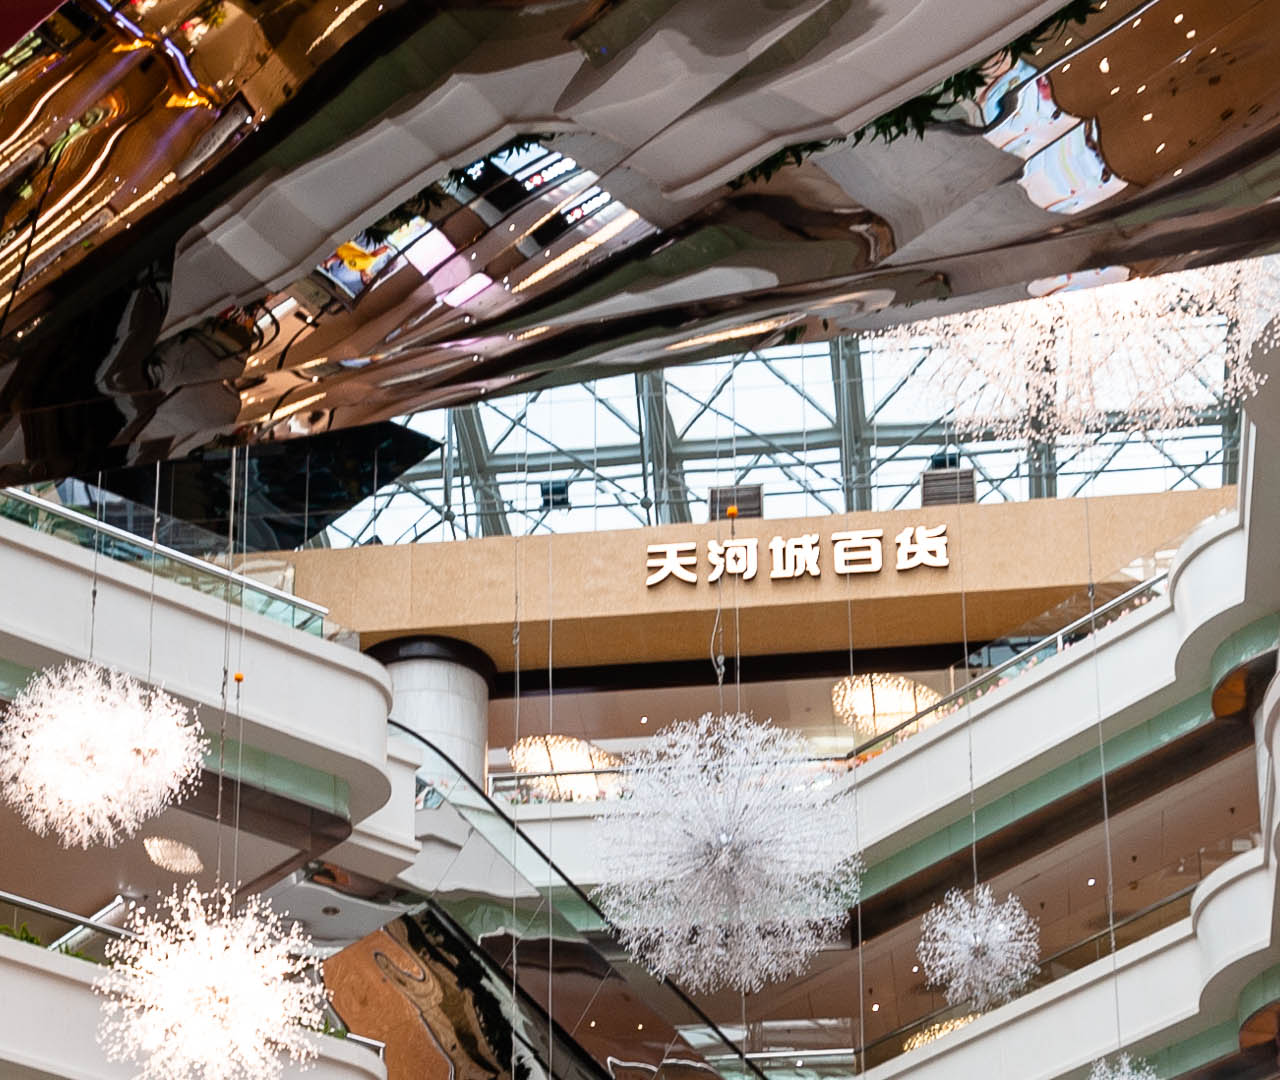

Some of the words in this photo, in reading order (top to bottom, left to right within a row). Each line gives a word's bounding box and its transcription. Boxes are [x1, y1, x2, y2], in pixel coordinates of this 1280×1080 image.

[646, 524, 950, 587] 天河城百货
